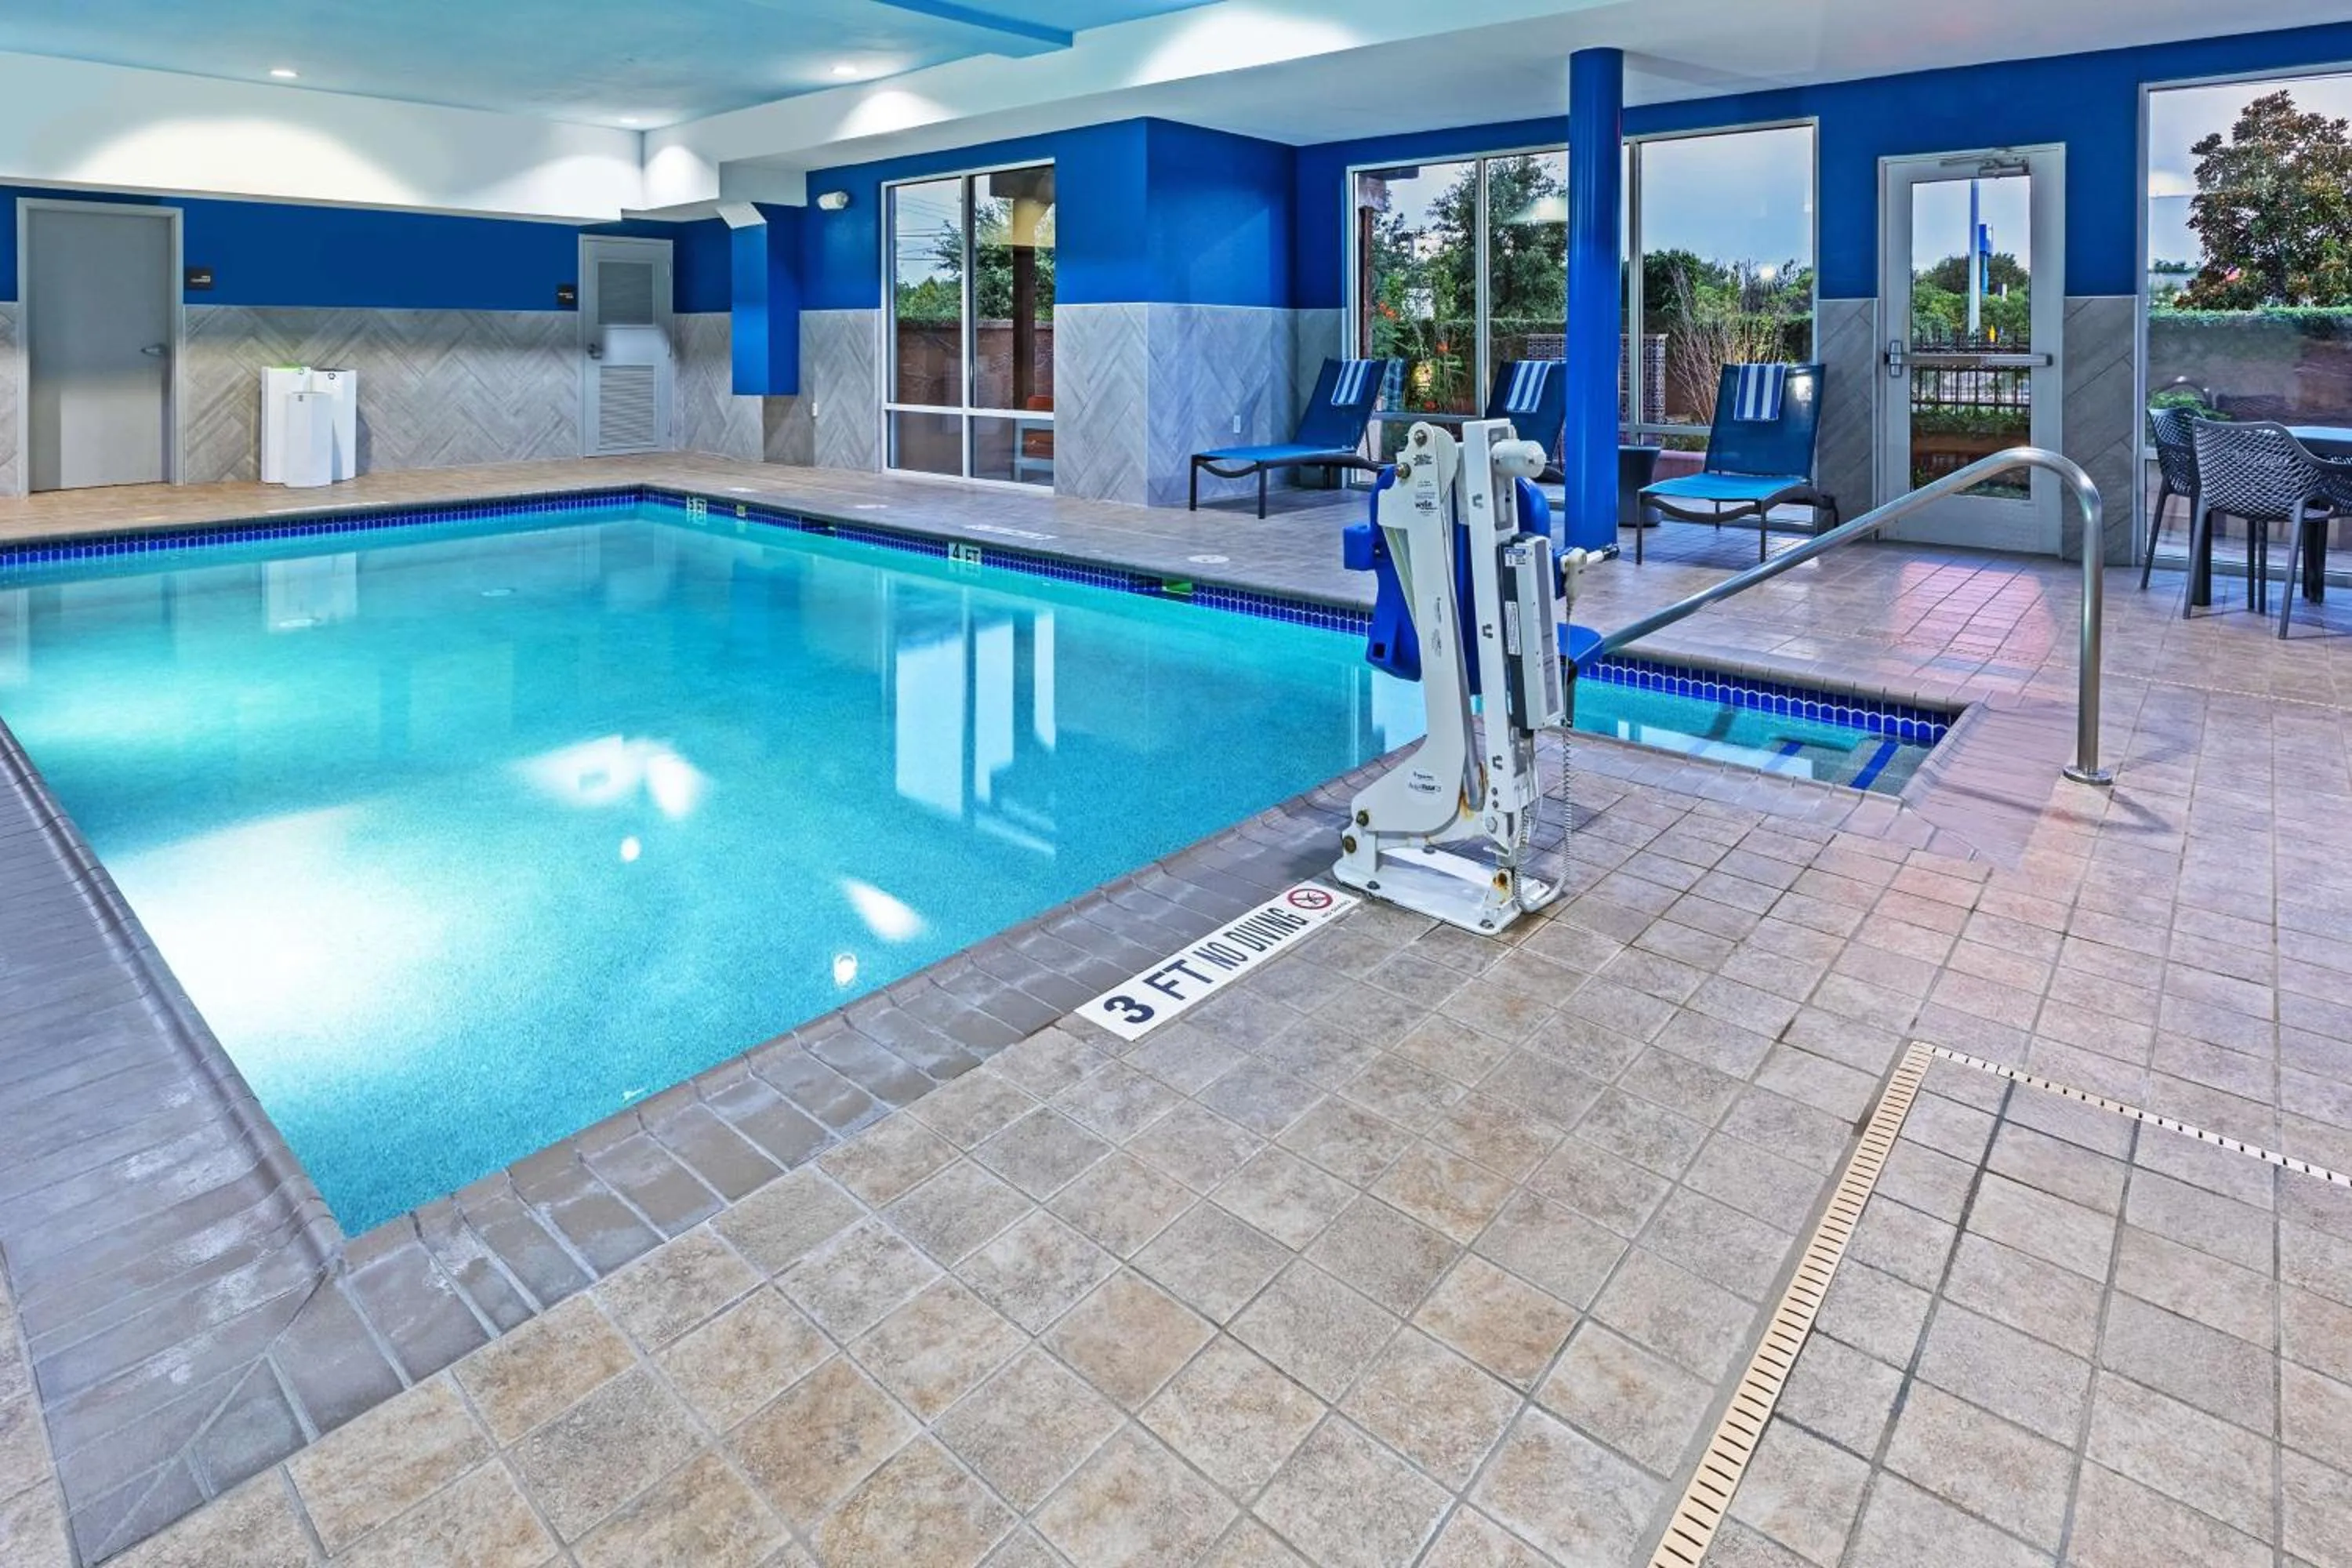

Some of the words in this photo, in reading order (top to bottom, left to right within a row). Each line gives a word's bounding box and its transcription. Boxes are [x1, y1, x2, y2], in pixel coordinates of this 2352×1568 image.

[953, 543, 960, 559] 4
[965, 548, 979, 563] FT
[1102, 995, 1155, 1024] 3
[1142, 958, 1214, 1001] FT
[1192, 942, 1249, 971] NO
[1226, 906, 1310, 953] DIVING
